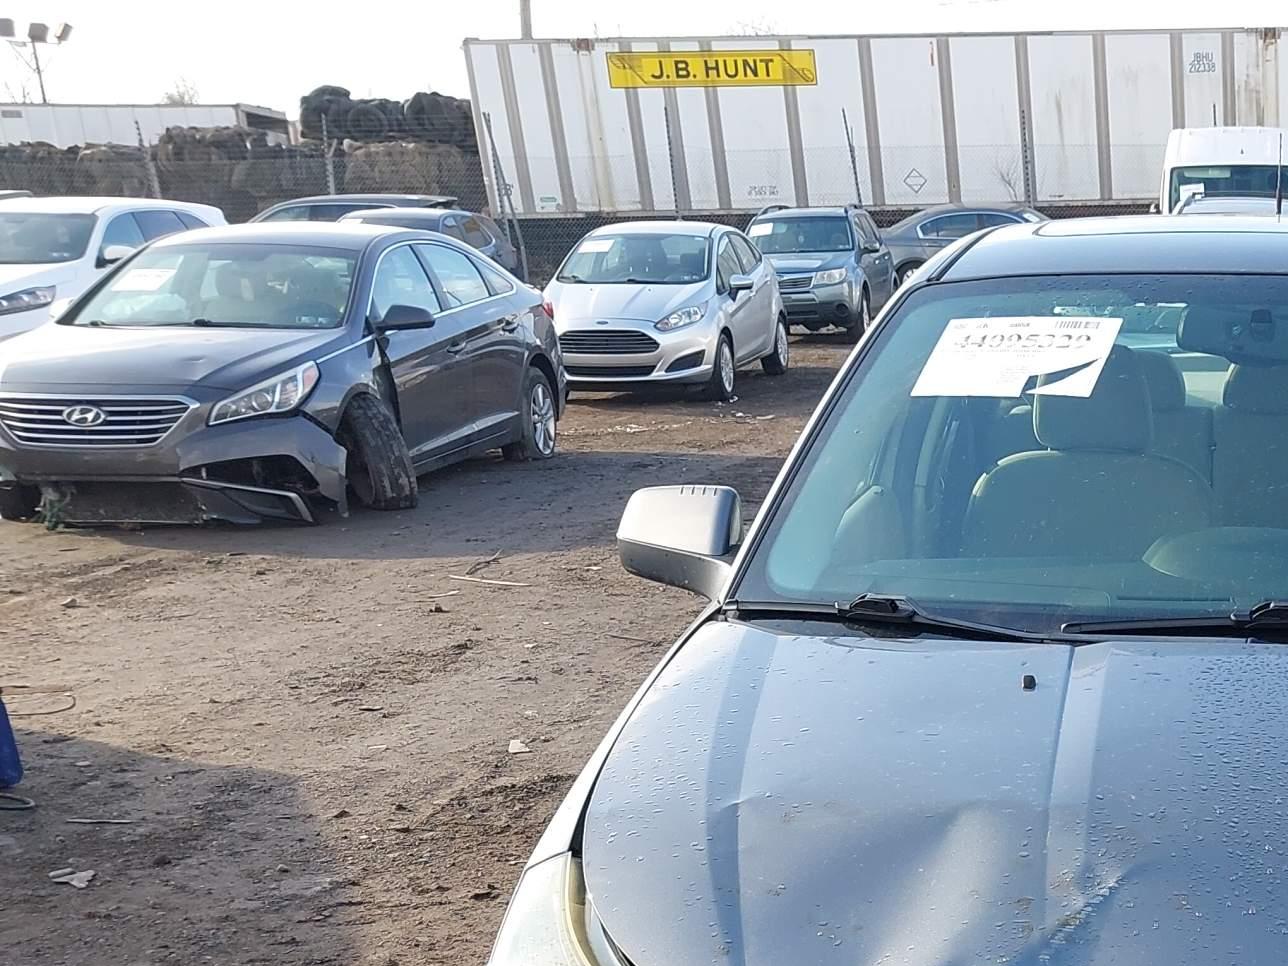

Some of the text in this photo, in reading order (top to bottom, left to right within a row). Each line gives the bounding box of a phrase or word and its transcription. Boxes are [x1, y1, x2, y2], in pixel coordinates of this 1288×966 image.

[1191, 51, 1214, 63] JBHU
[651, 58, 775, 80] J.B. HUNT
